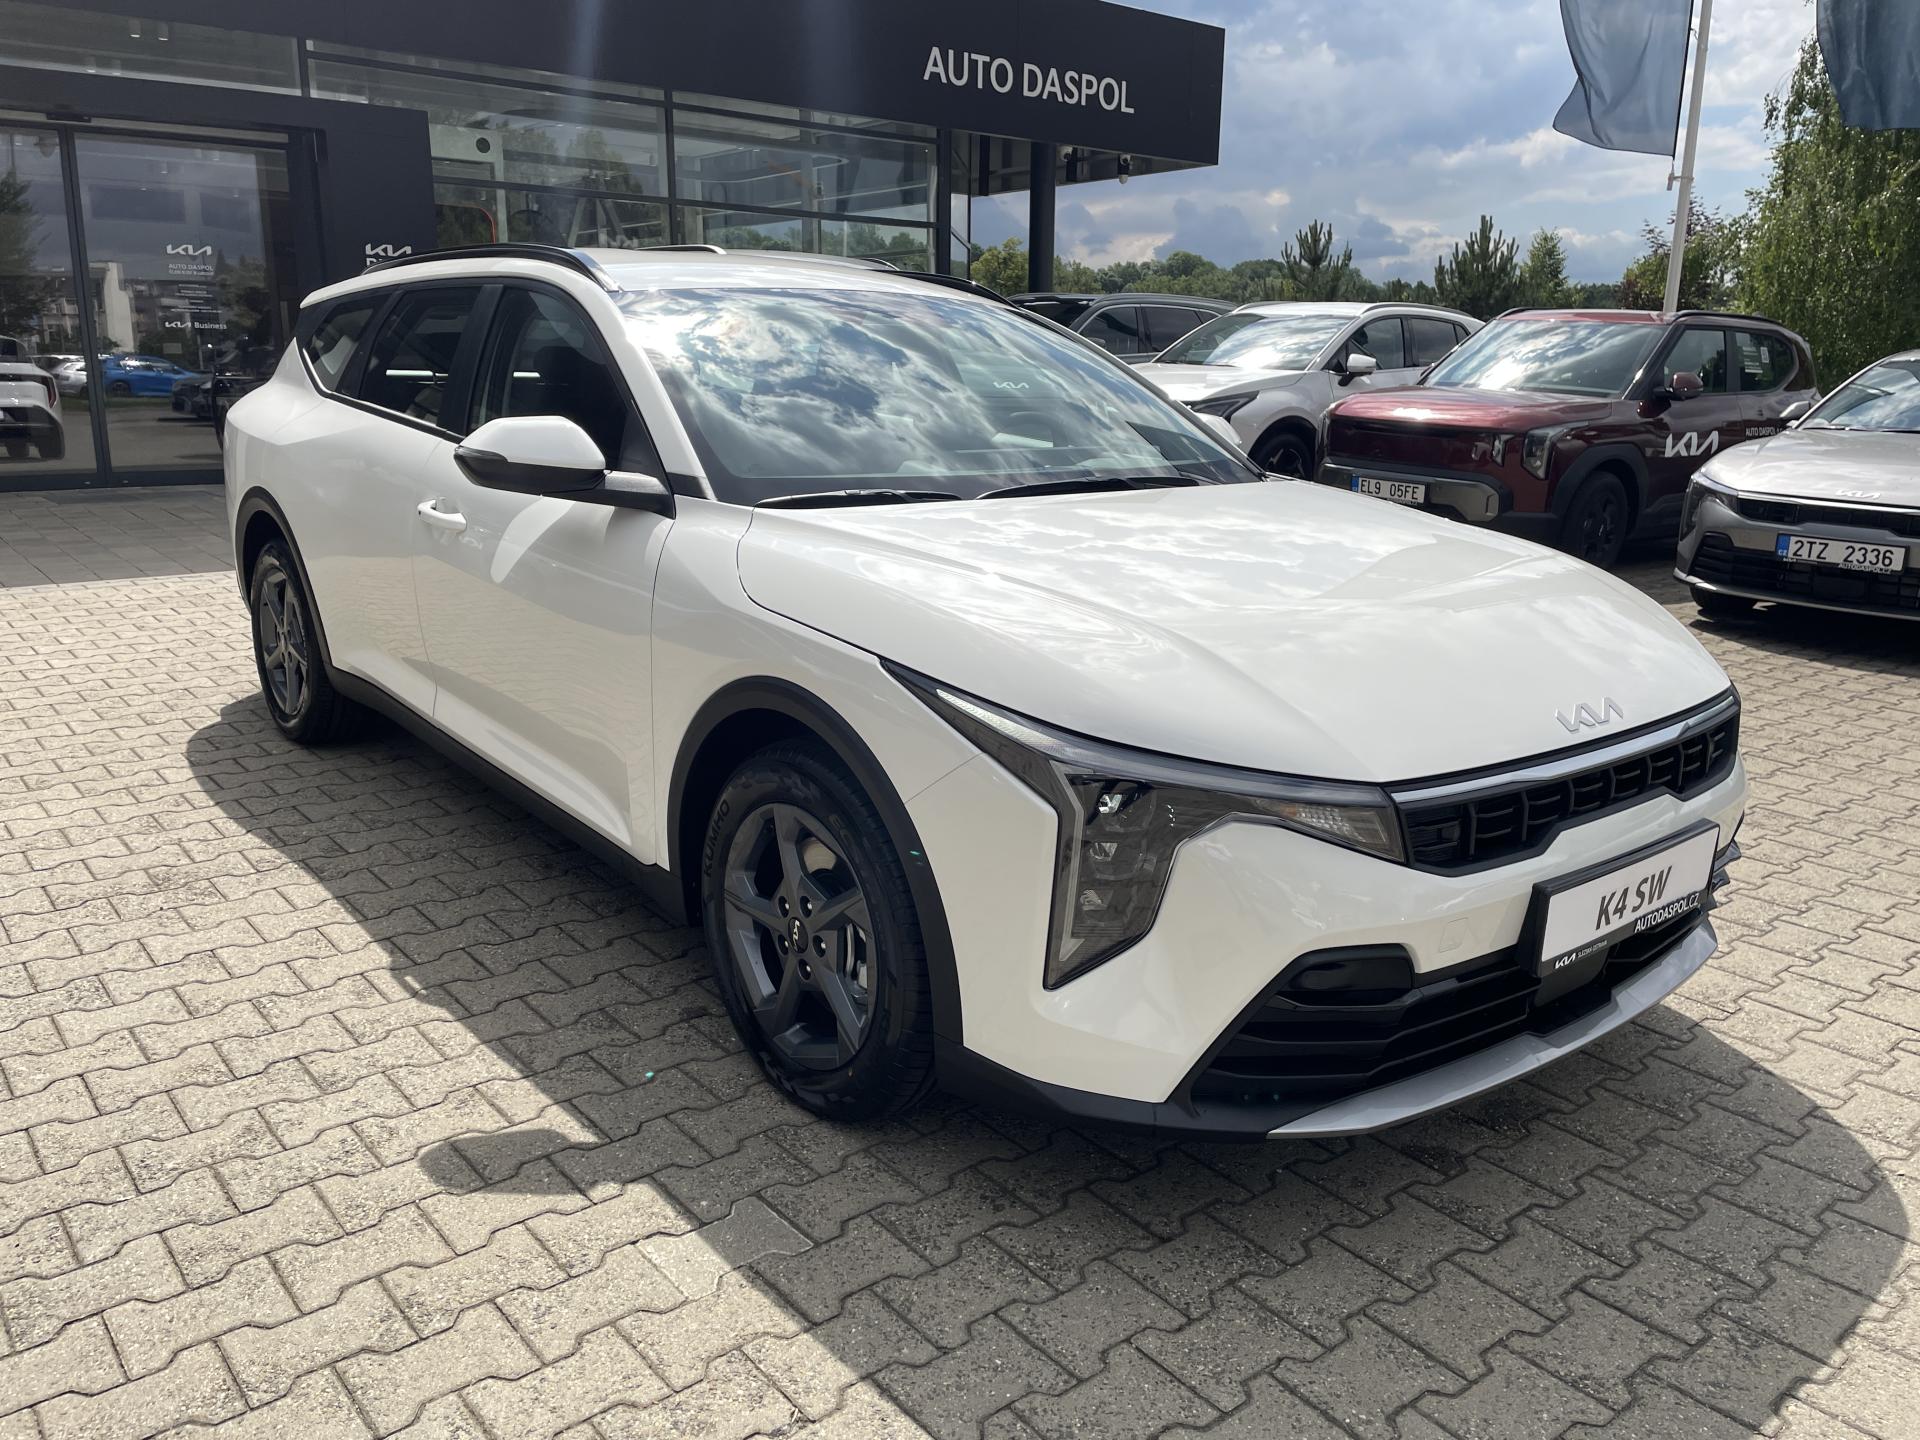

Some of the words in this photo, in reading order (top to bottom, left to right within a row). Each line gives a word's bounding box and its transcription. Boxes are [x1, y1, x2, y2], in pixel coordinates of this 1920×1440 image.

[923, 46, 1014, 93] AUTO
[1023, 62, 1135, 113] DASPOL
[165, 243, 213, 256] KIA
[365, 243, 412, 257] KIA
[194, 321, 227, 330] Business
[1664, 430, 1719, 458] KIA
[1745, 426, 1759, 437] AUTO
[1360, 479, 1381, 495] EL9
[1389, 483, 1419, 500] 05FE
[1792, 539, 1829, 560] 2TZ
[1843, 545, 1894, 568] 2336
[1555, 696, 1624, 732] KIA
[704, 799, 730, 878] KUMHO
[1595, 887, 1629, 931] K4
[1631, 865, 1673, 913] SW
[1634, 892, 1700, 934] AUTODASPOL.CZ
[1555, 952, 1576, 969] KIA
